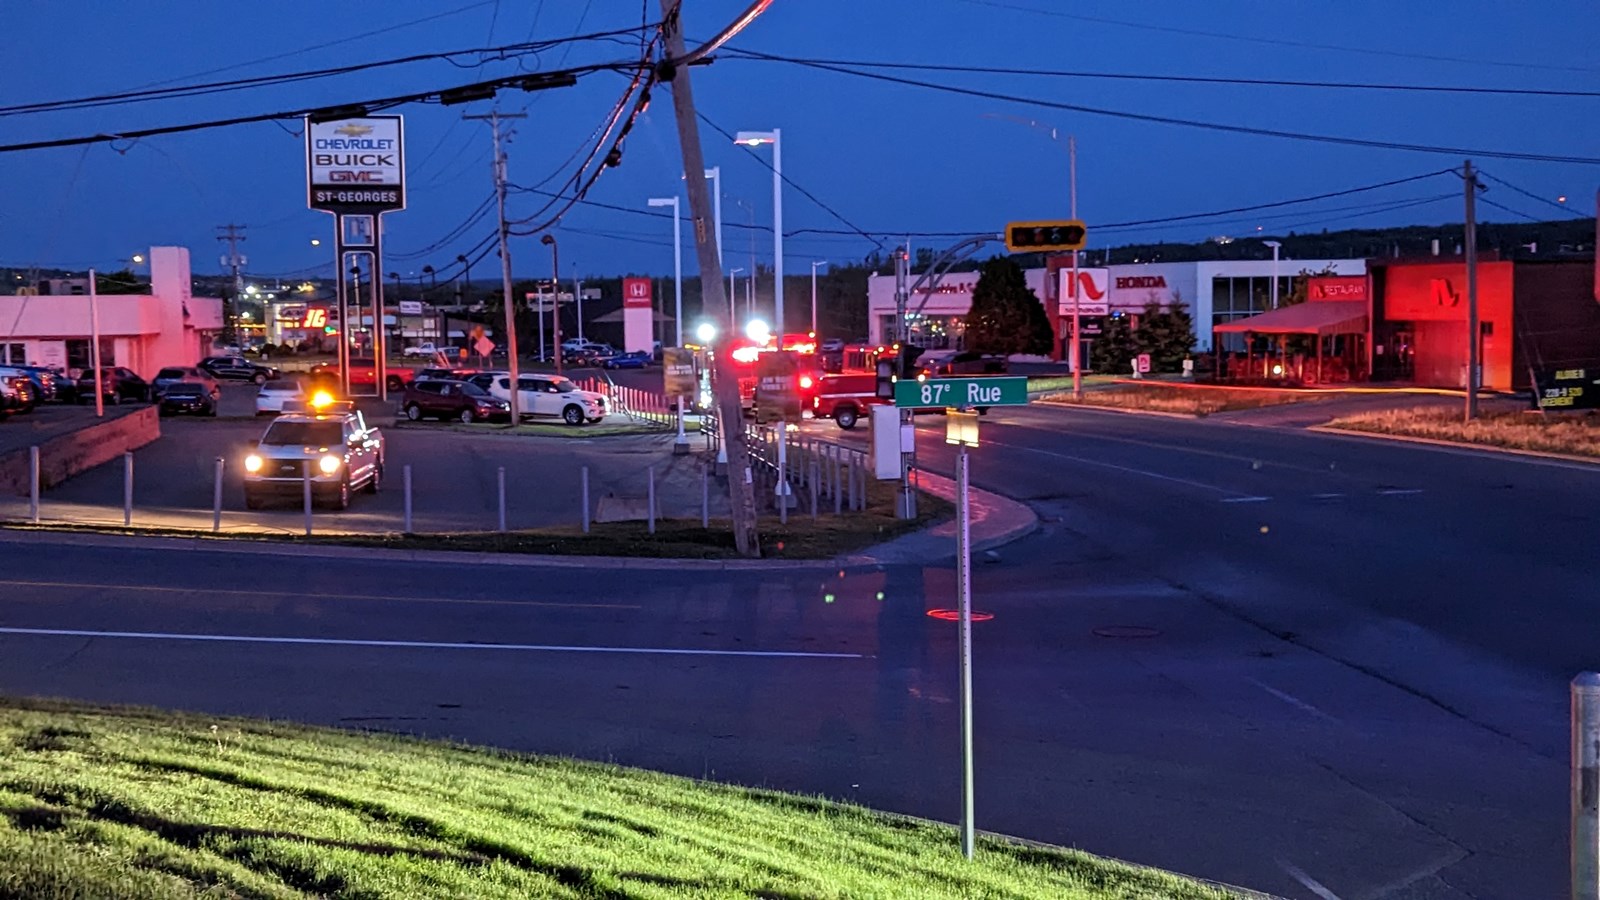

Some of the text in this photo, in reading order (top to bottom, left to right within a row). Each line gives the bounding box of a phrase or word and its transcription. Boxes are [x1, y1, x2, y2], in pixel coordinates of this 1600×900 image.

[316, 139, 394, 149] CHEVROLET
[315, 154, 395, 166] BUICK
[329, 171, 383, 182] GMC
[317, 192, 397, 202] ST-GEORGES
[1115, 276, 1167, 289] HONDA
[967, 382, 1002, 403] Rue
